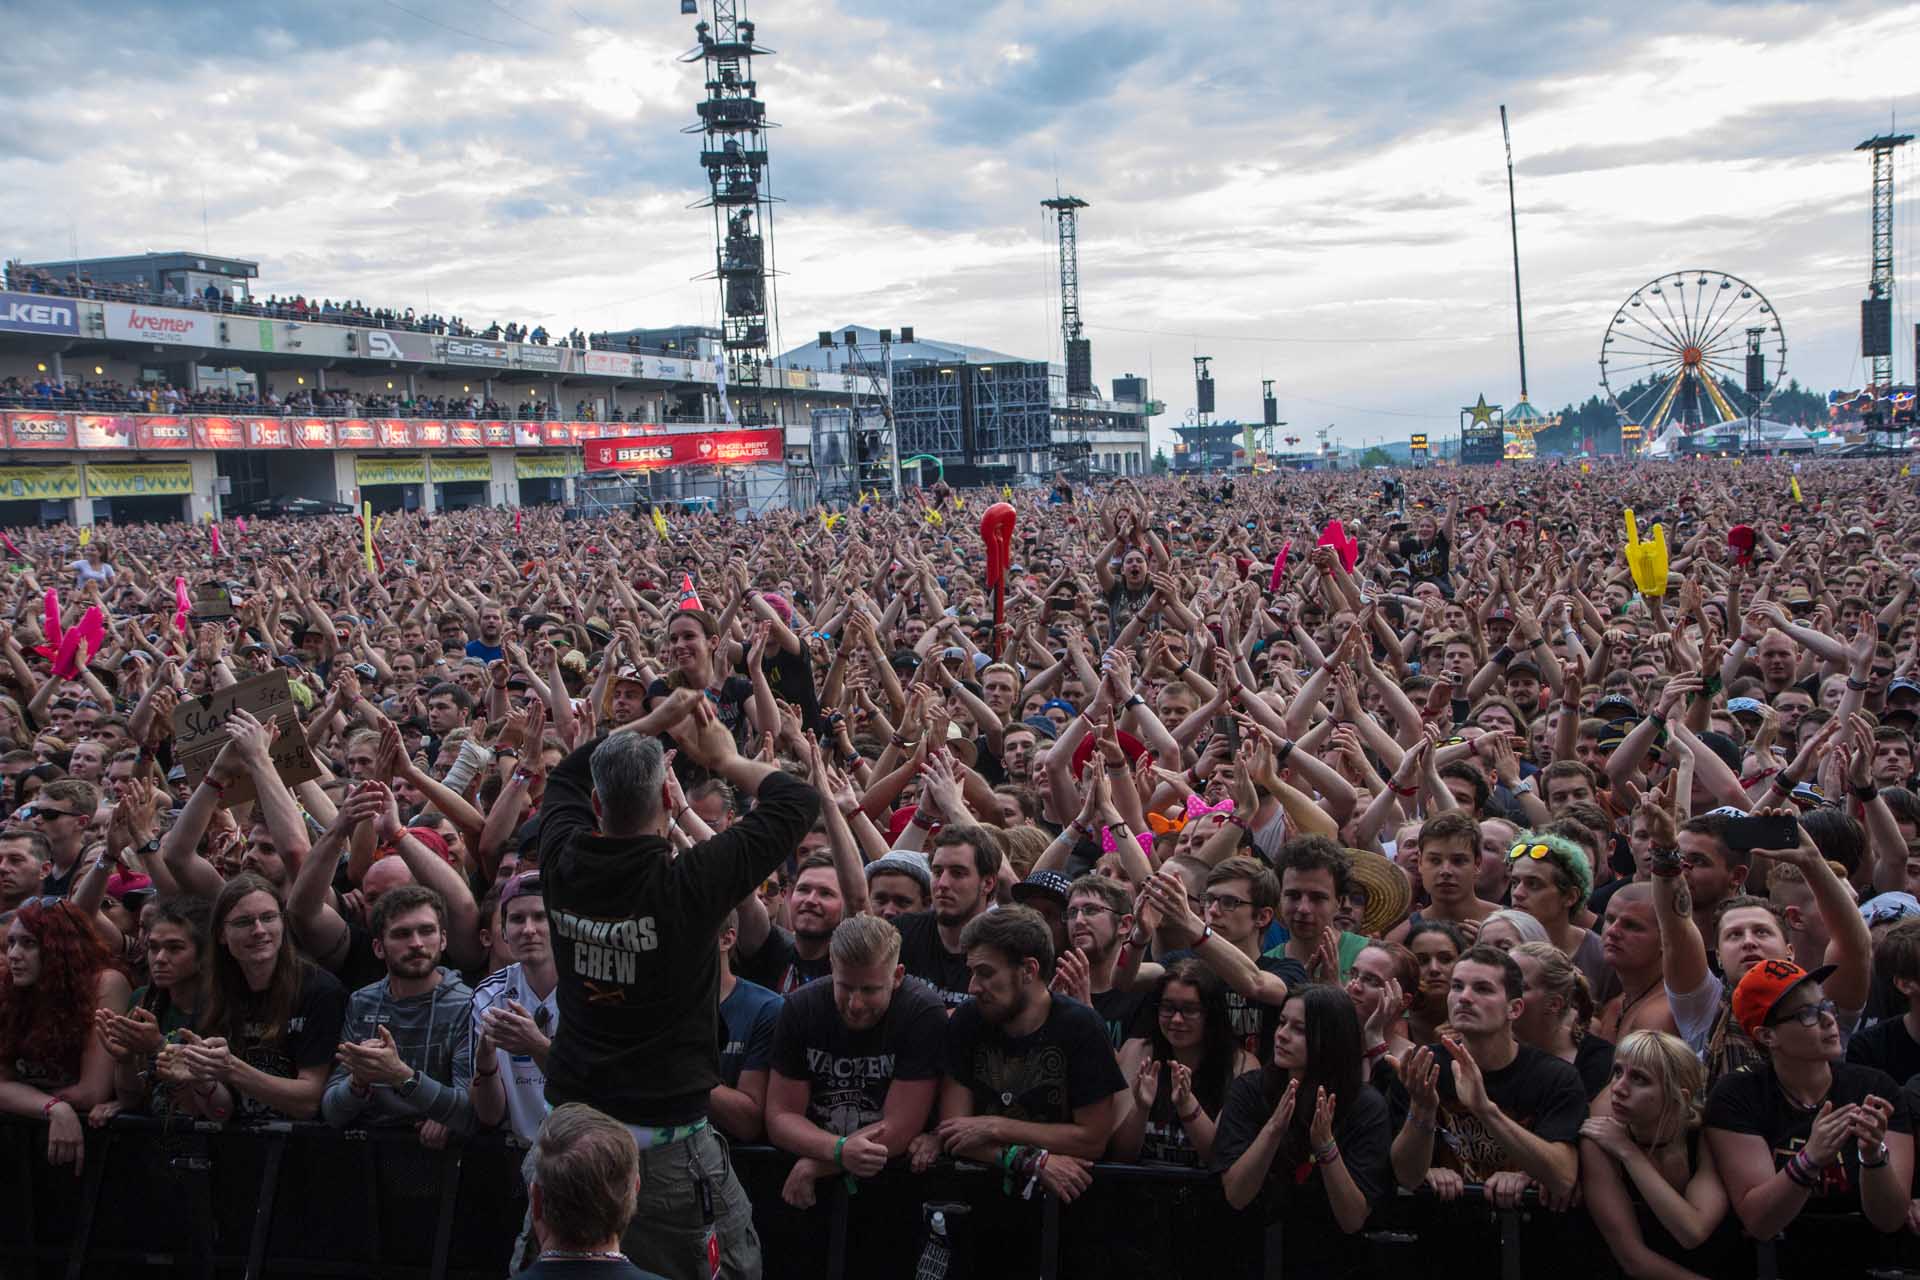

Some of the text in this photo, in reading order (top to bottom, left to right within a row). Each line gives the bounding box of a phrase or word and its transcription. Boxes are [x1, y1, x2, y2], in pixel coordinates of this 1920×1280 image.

[128, 309, 194, 333] kremer
[717, 442, 768, 450] ENGELBERT
[617, 447, 673, 461] BECK'S
[717, 449, 768, 458] STRAUSS
[574, 942, 637, 984] CREW
